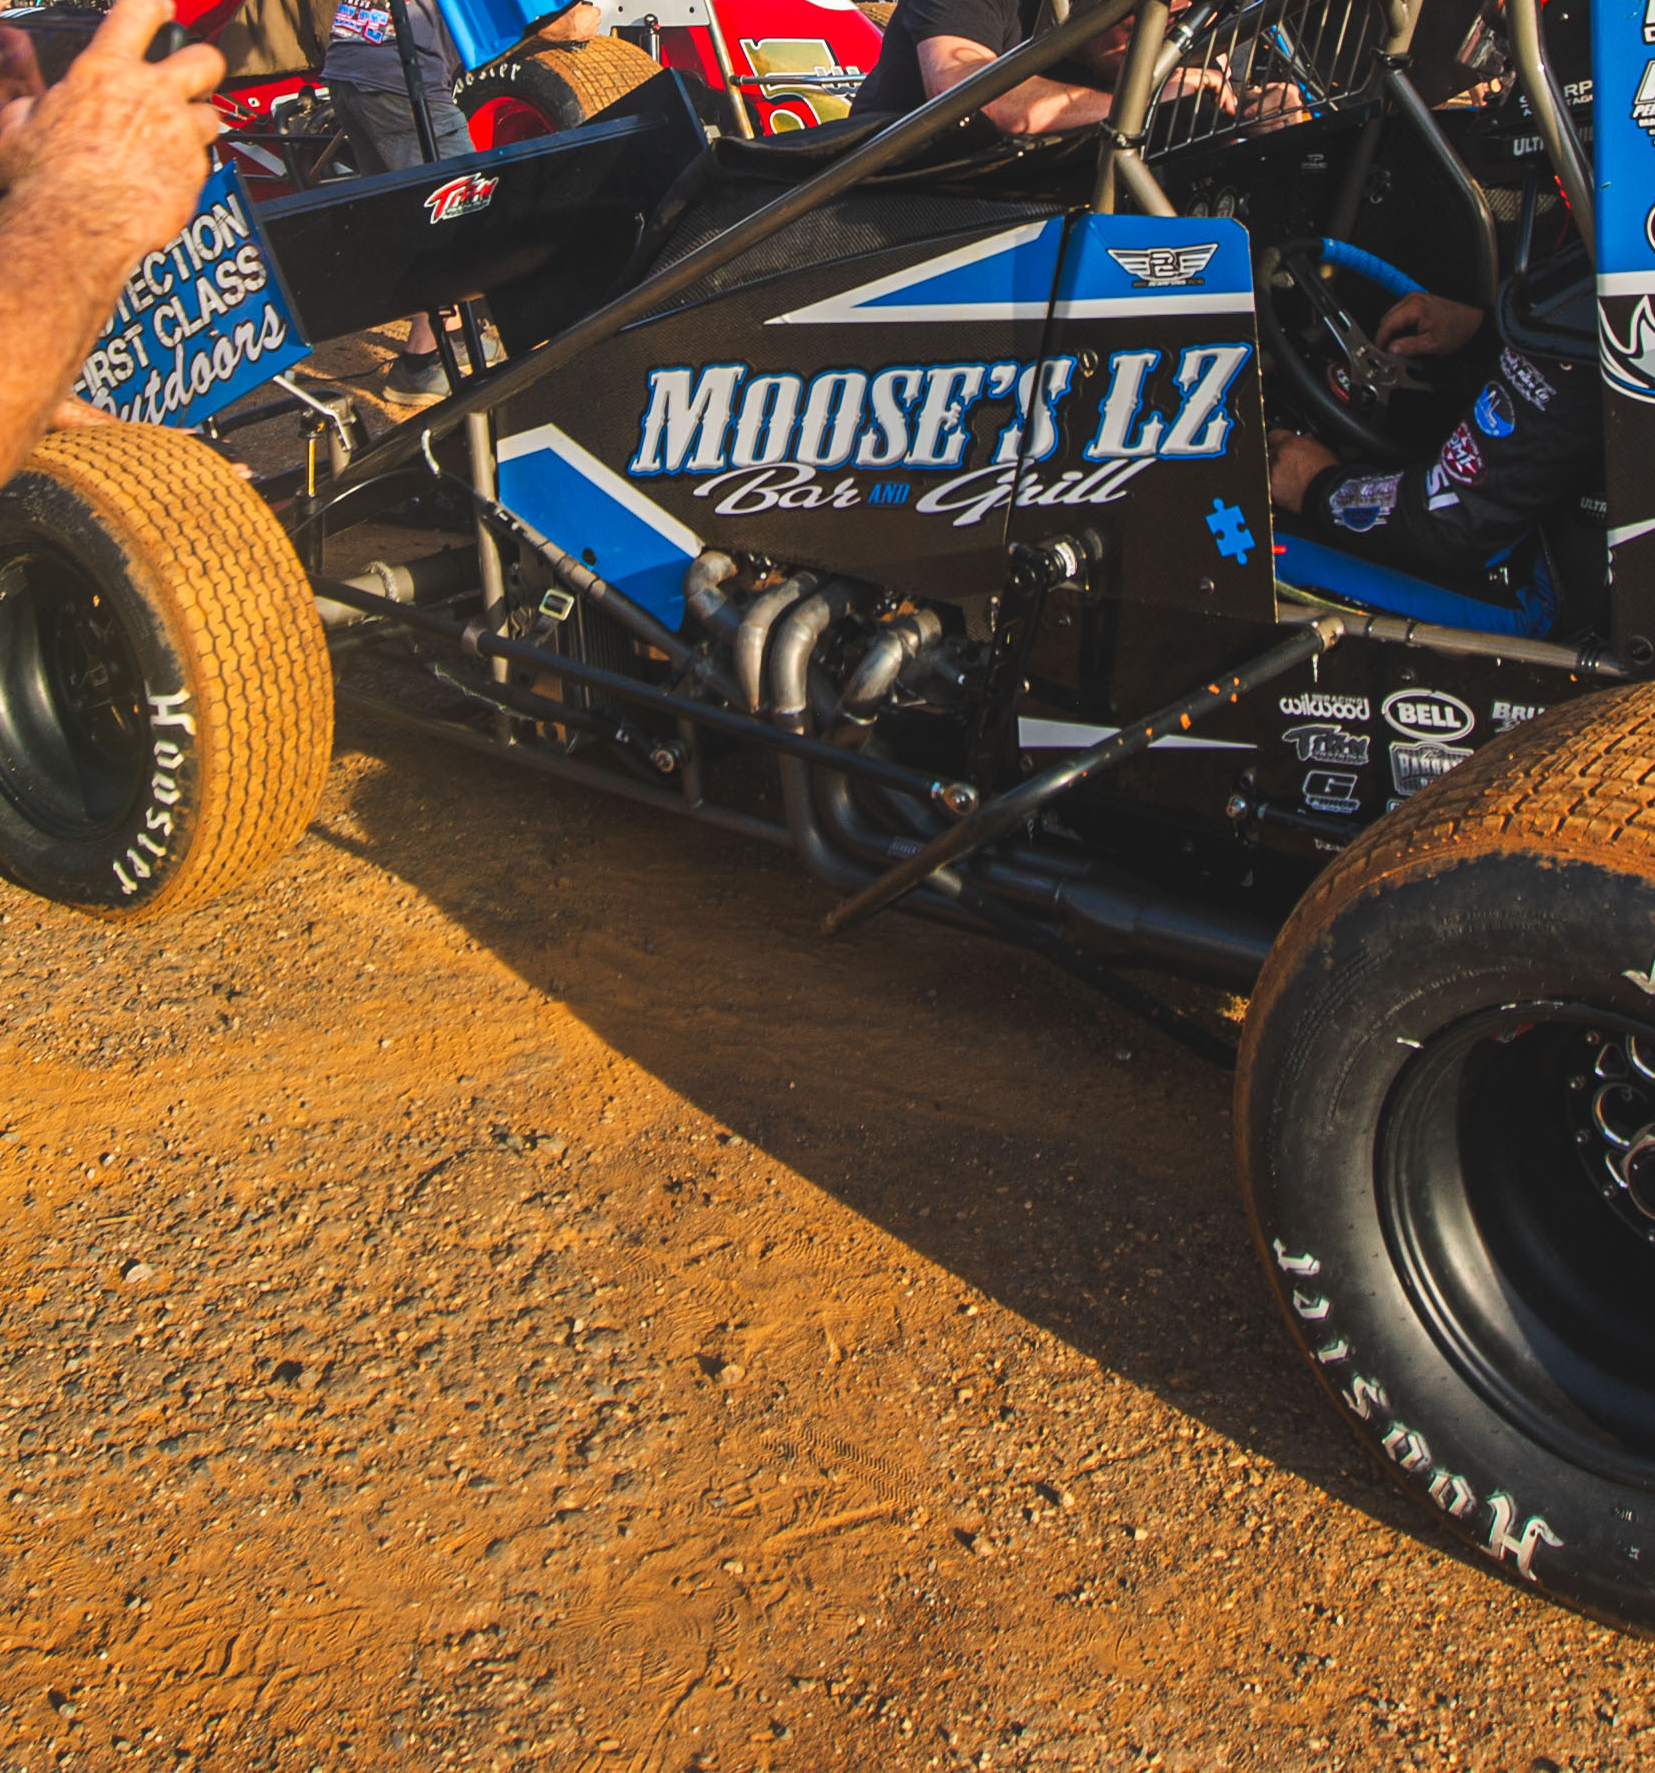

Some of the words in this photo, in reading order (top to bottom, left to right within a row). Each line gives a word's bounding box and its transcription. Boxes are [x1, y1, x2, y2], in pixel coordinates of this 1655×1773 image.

[153, 245, 266, 347] CLASS
[631, 356, 1076, 474] MOOSE'S
[1087, 342, 1252, 461] LZ
[694, 461, 860, 515] Bar
[868, 483, 908, 505] AND
[916, 458, 1156, 526] Grill
[1280, 693, 1370, 721] wilwood
[1397, 702, 1461, 728] BELL
